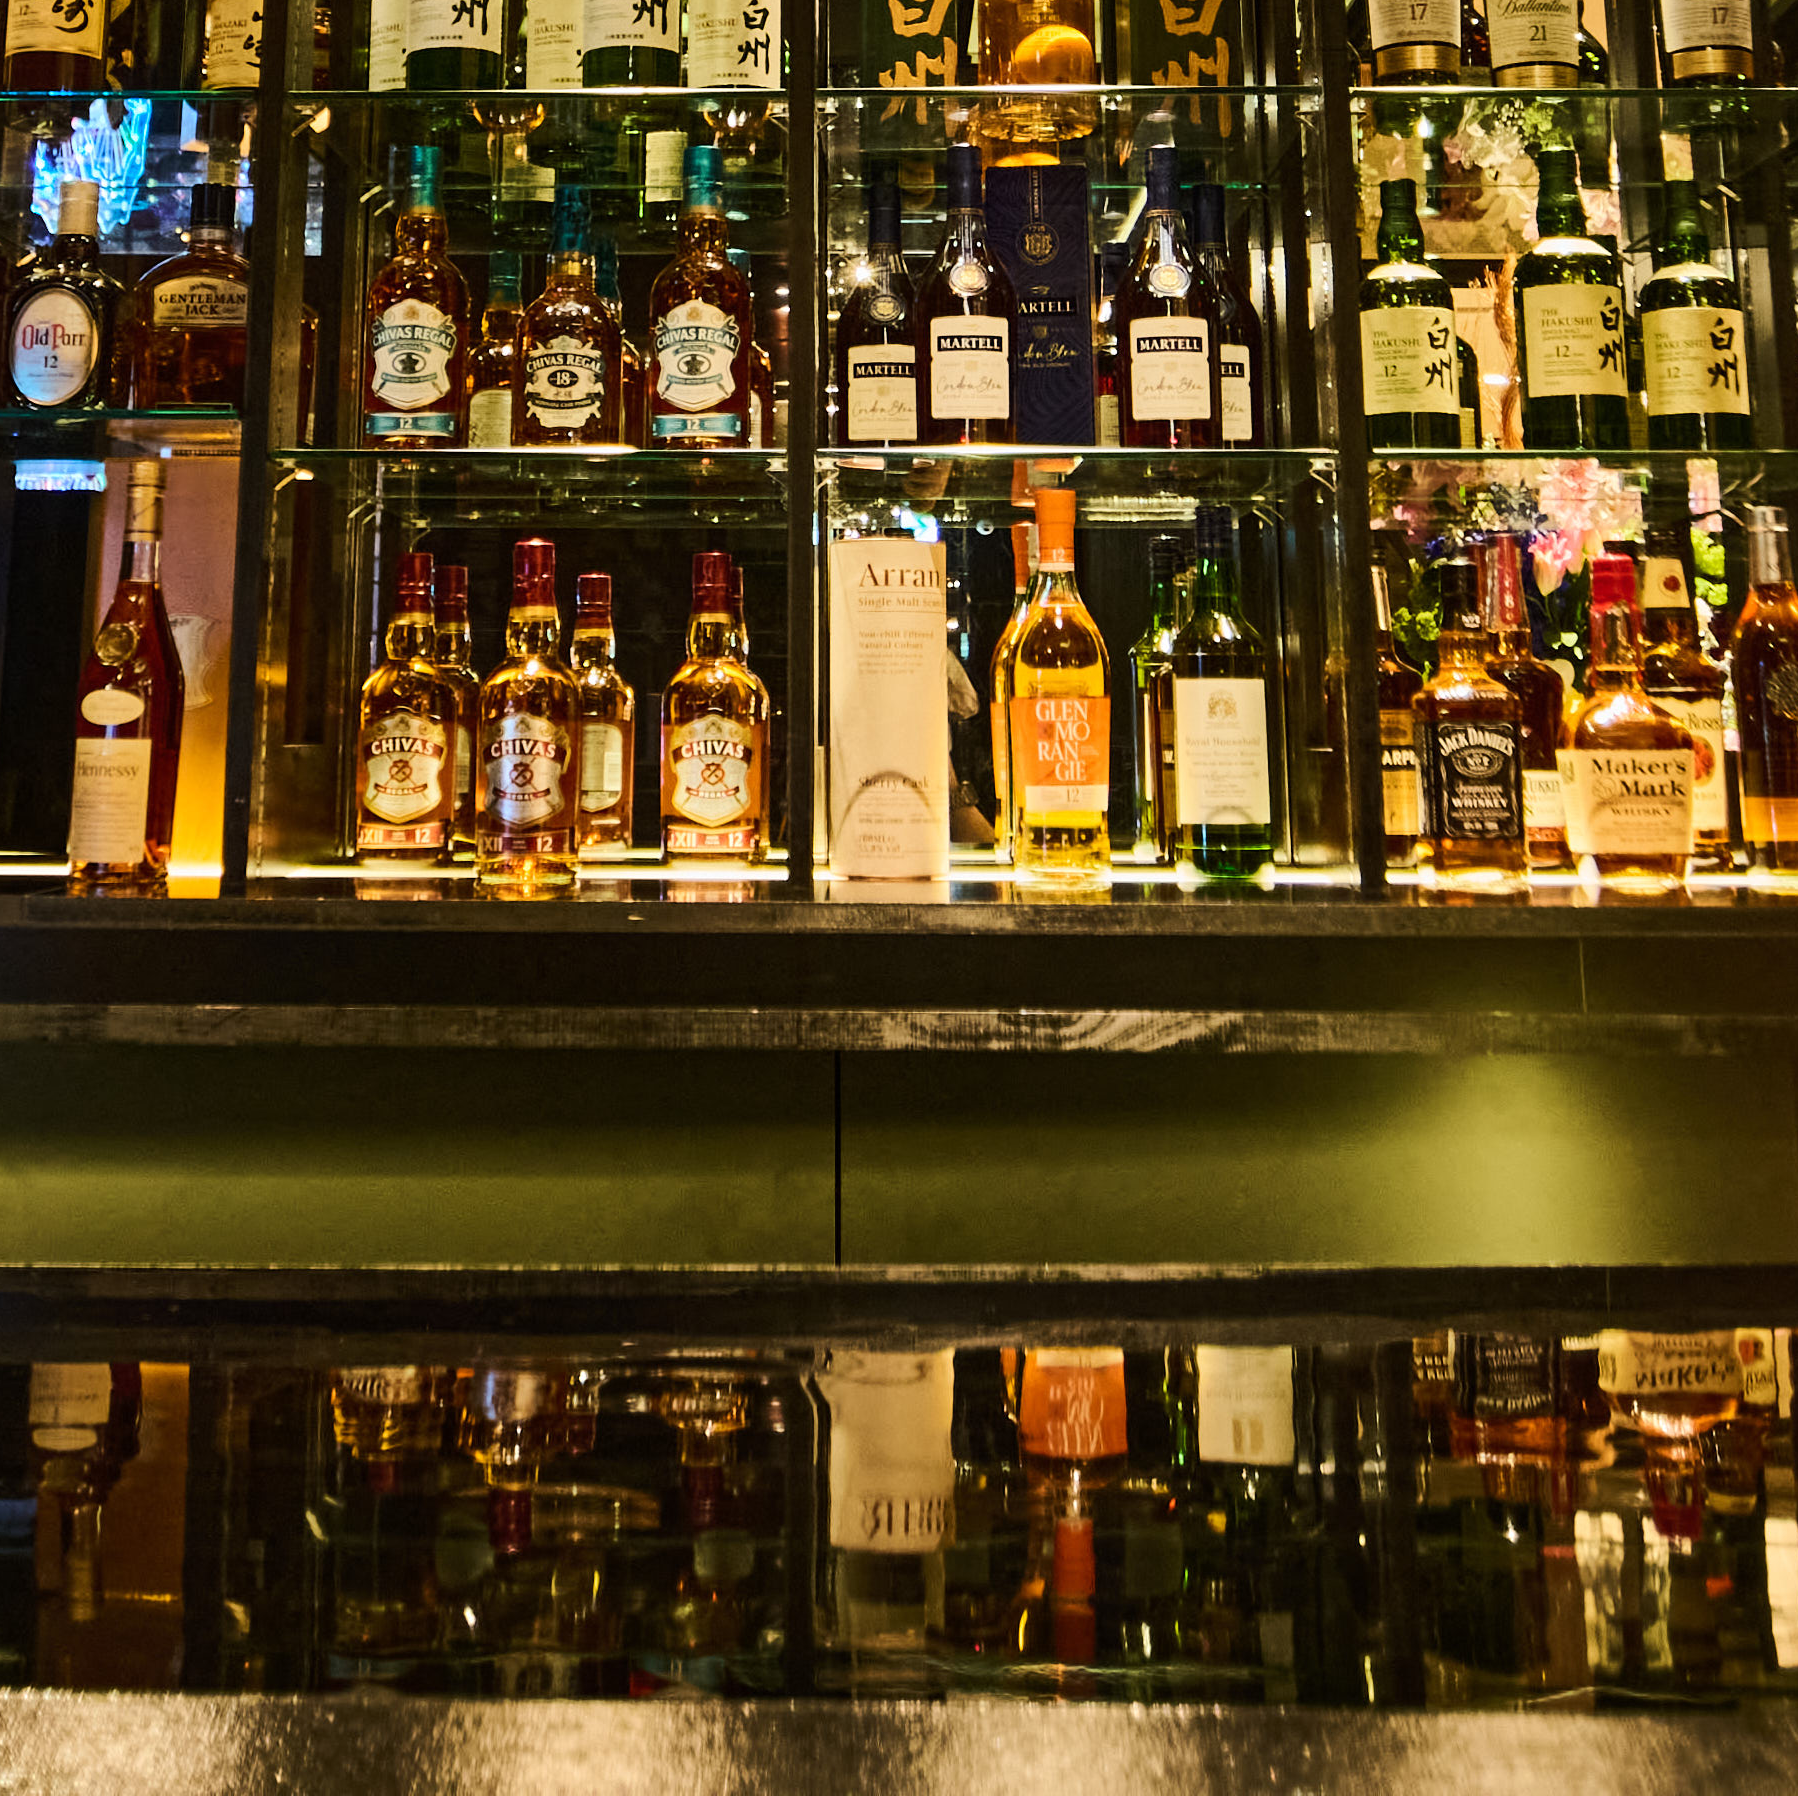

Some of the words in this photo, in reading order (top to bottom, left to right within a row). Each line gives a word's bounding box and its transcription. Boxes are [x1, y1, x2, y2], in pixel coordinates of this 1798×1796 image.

[1409, 3, 1428, 21] 17
[1711, 7, 1728, 25] 17
[1529, 25, 1547, 42] 21
[158, 293, 247, 304] GENTLEMAN
[1018, 300, 1073, 314] ARTELL
[185, 304, 220, 316] JACK
[1540, 317, 1597, 328] HAKUSHU
[21, 322, 49, 352] Old
[51, 322, 87, 351] Parr
[372, 326, 414, 348] CHIVAS
[414, 326, 453, 349] REGAL
[656, 328, 697, 349] CHIVAS
[697, 327, 737, 350] REGAL
[940, 336, 1000, 352] MARTELL
[1139, 337, 1200, 352] MARTELL
[1372, 338, 1423, 348] HAKUSHU
[1598, 295, 1626, 380] 白州
[1424, 316, 1454, 396] 白州
[1554, 345, 1571, 359] 12
[1707, 316, 1742, 396] 白州
[43, 354, 59, 370] 12
[526, 354, 565, 374] CHIVAS
[566, 353, 603, 374] REGAL
[855, 364, 912, 377] MARTELL
[556, 371, 571, 386] 18
[1383, 365, 1398, 379] 12
[1666, 366, 1681, 379] 12
[398, 417, 414, 430] 12
[686, 418, 701, 431] 12
[1052, 549, 1066, 563] 12
[858, 562, 941, 589] Arran
[858, 595, 891, 609] Single
[896, 595, 921, 608] Malt
[1035, 700, 1088, 722] GLEN
[1055, 722, 1091, 742] MO
[370, 738, 435, 757] CHIVAS
[490, 739, 556, 759] CHIVAS
[680, 739, 744, 759] CHIVAS
[1037, 742, 1079, 761] RAN
[1438, 730, 1468, 757] JACK
[76, 761, 140, 781] Hennessy
[1054, 761, 1087, 782] GIE
[1591, 757, 1688, 776] Maker's
[858, 775, 898, 792] Sherry
[902, 775, 930, 789] Cask
[1618, 779, 1687, 798] Mark
[1065, 788, 1080, 803] 12
[1451, 797, 1508, 810] WHISKEY
[414, 829, 431, 845] 12
[536, 835, 553, 852] 12
[728, 831, 744, 848] 12
